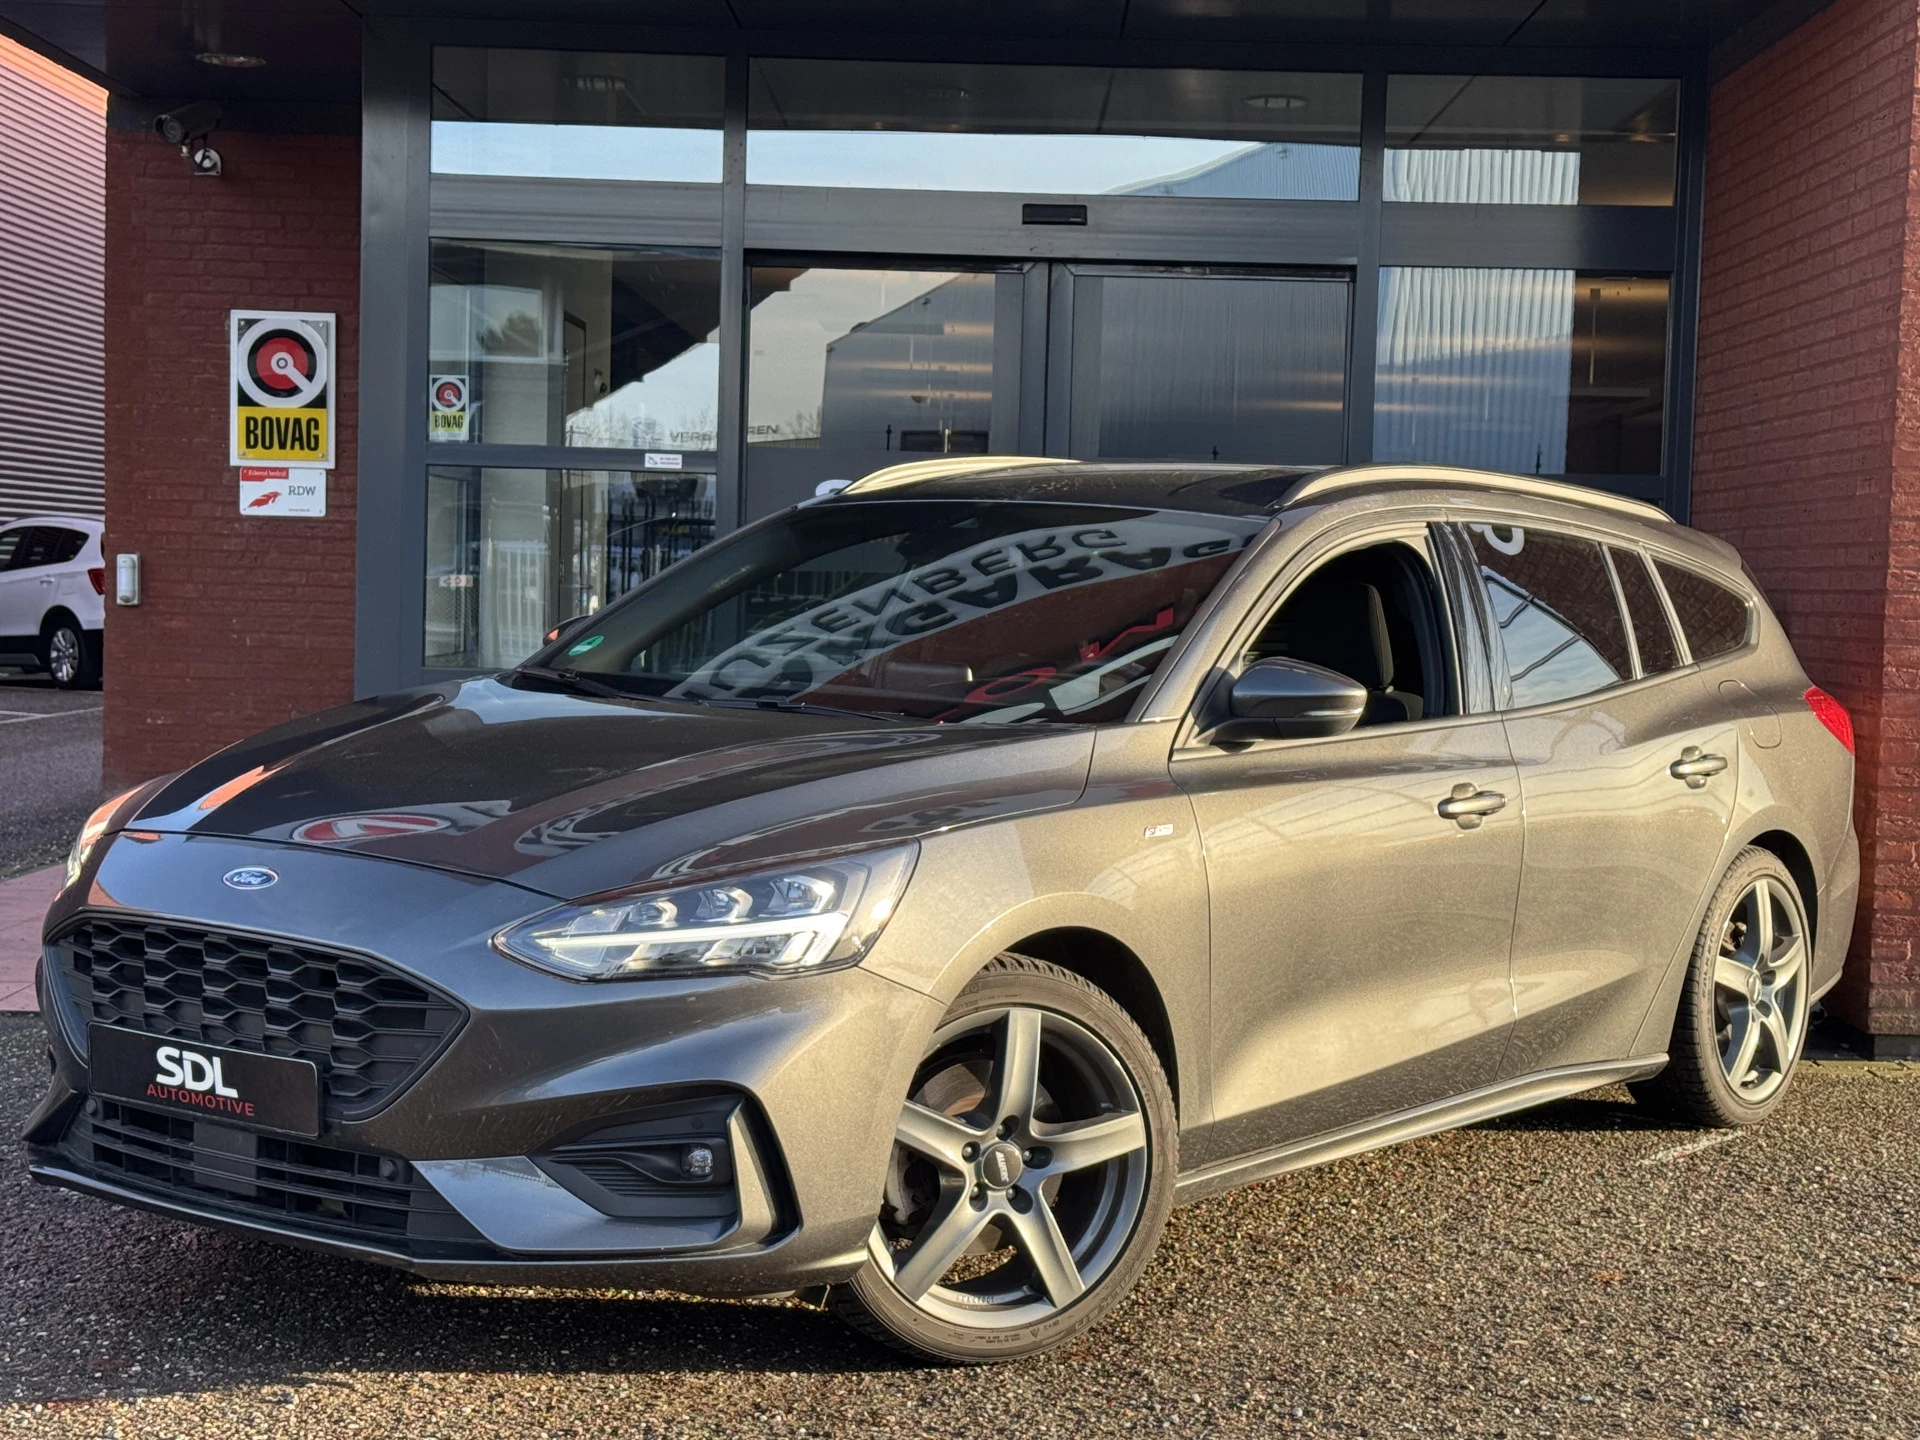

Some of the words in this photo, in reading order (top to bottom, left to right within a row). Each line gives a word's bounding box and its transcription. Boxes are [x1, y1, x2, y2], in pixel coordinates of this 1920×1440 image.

[245, 415, 320, 452] BOVAG
[434, 414, 464, 429] BOVAG
[288, 485, 316, 497] RDW
[233, 871, 267, 885] Ford
[156, 1046, 239, 1098] SDL
[146, 1083, 255, 1117] AUTOMOTIVE
